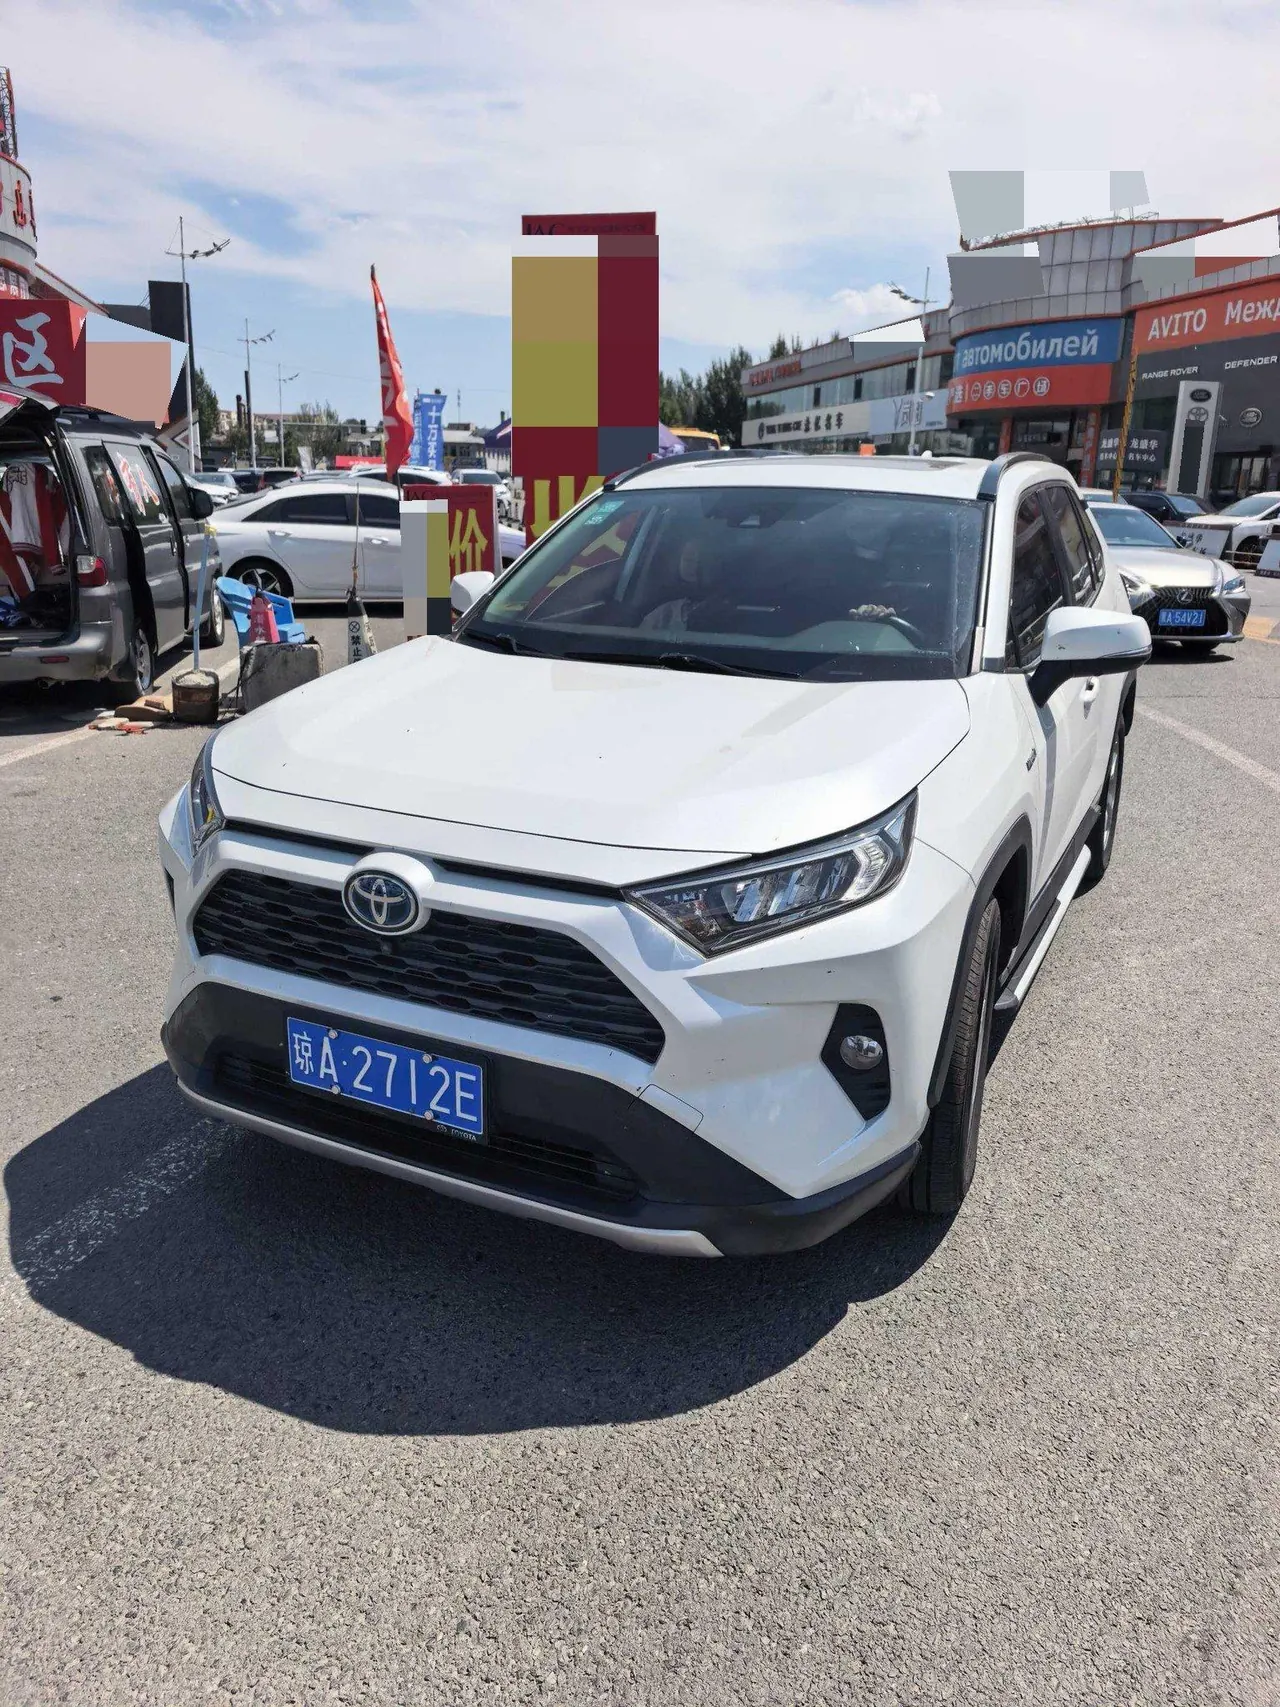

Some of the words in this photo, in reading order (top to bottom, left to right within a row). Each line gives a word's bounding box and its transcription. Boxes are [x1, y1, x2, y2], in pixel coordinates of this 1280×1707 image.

[1147, 308, 1207, 341] AVITO
[962, 328, 1099, 369] автомобилей
[1224, 355, 1278, 370] DEFENDER
[1142, 370, 1169, 380] RANGE
[1170, 366, 1199, 378] ROVER
[451, 1128, 477, 1141] TOYOTA
